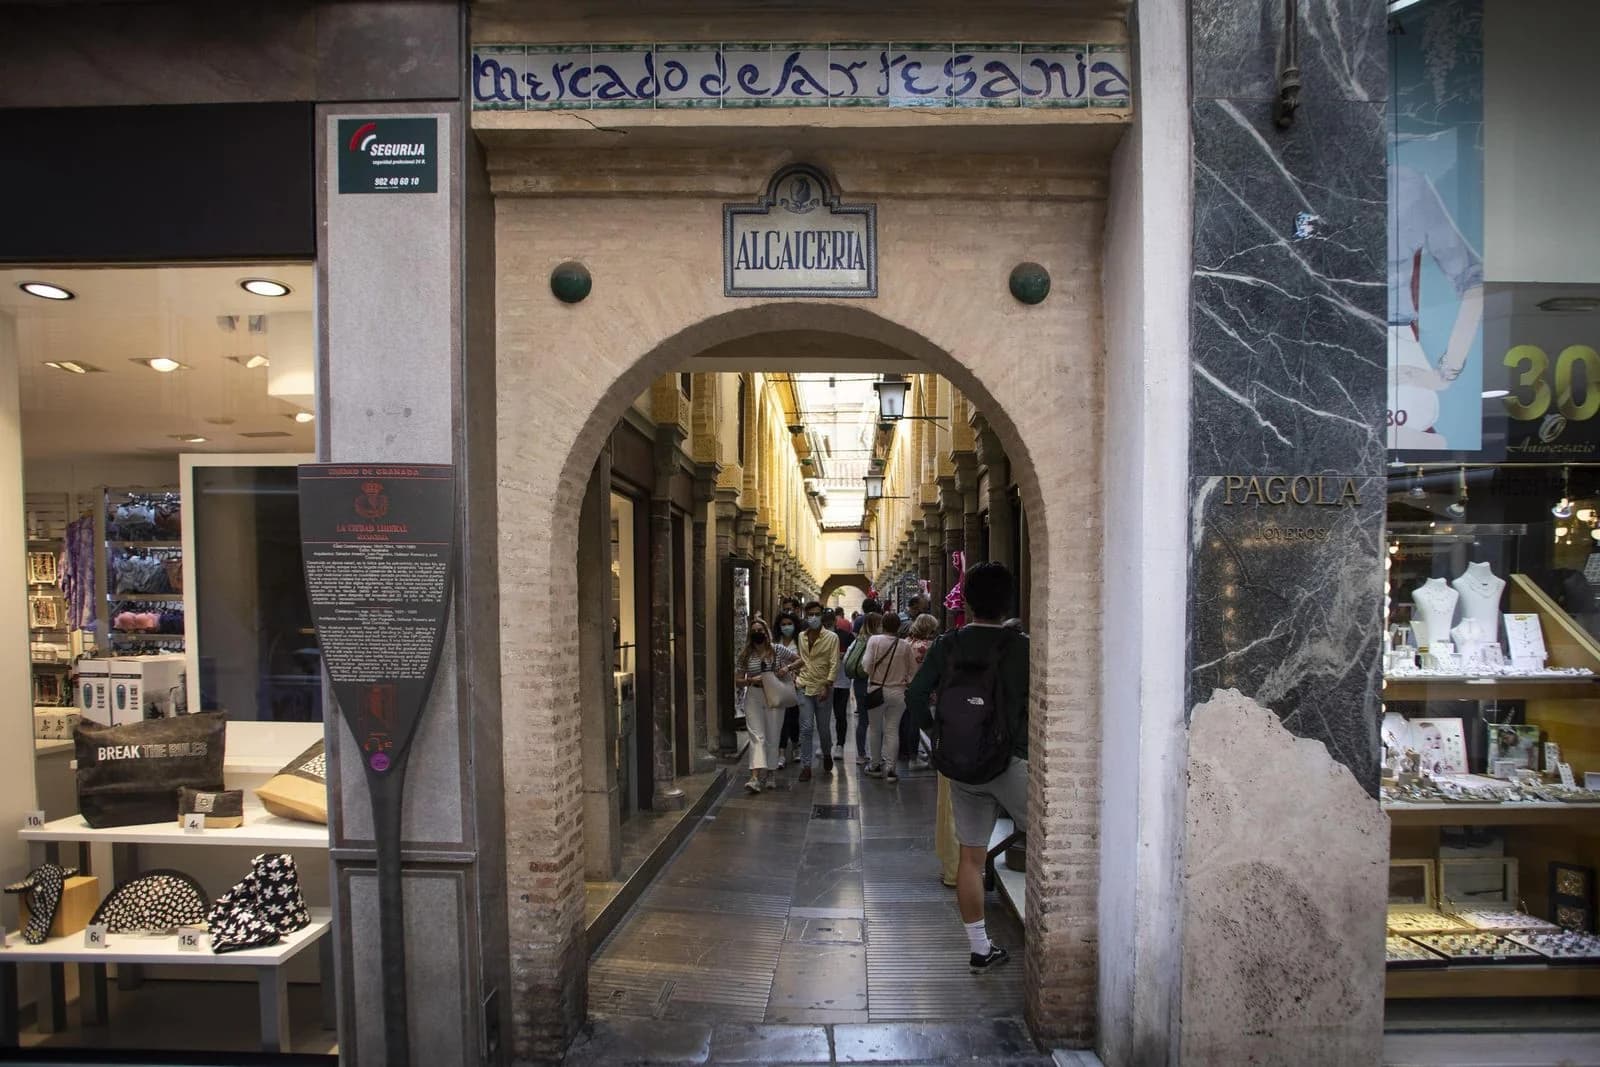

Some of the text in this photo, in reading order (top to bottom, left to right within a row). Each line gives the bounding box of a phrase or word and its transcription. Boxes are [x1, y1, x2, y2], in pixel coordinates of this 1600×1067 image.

[473, 51, 688, 101] Mercado
[700, 51, 771, 97] de
[370, 144, 425, 156] SEGURIJA
[411, 177, 419, 185] 10
[735, 231, 866, 270] ALCAICERIA
[1503, 345, 1600, 421] 30
[1506, 436, 1596, 454] Aniversario
[1224, 475, 1362, 506] PAGOLA
[98, 742, 208, 761] BREAK THE RULES
